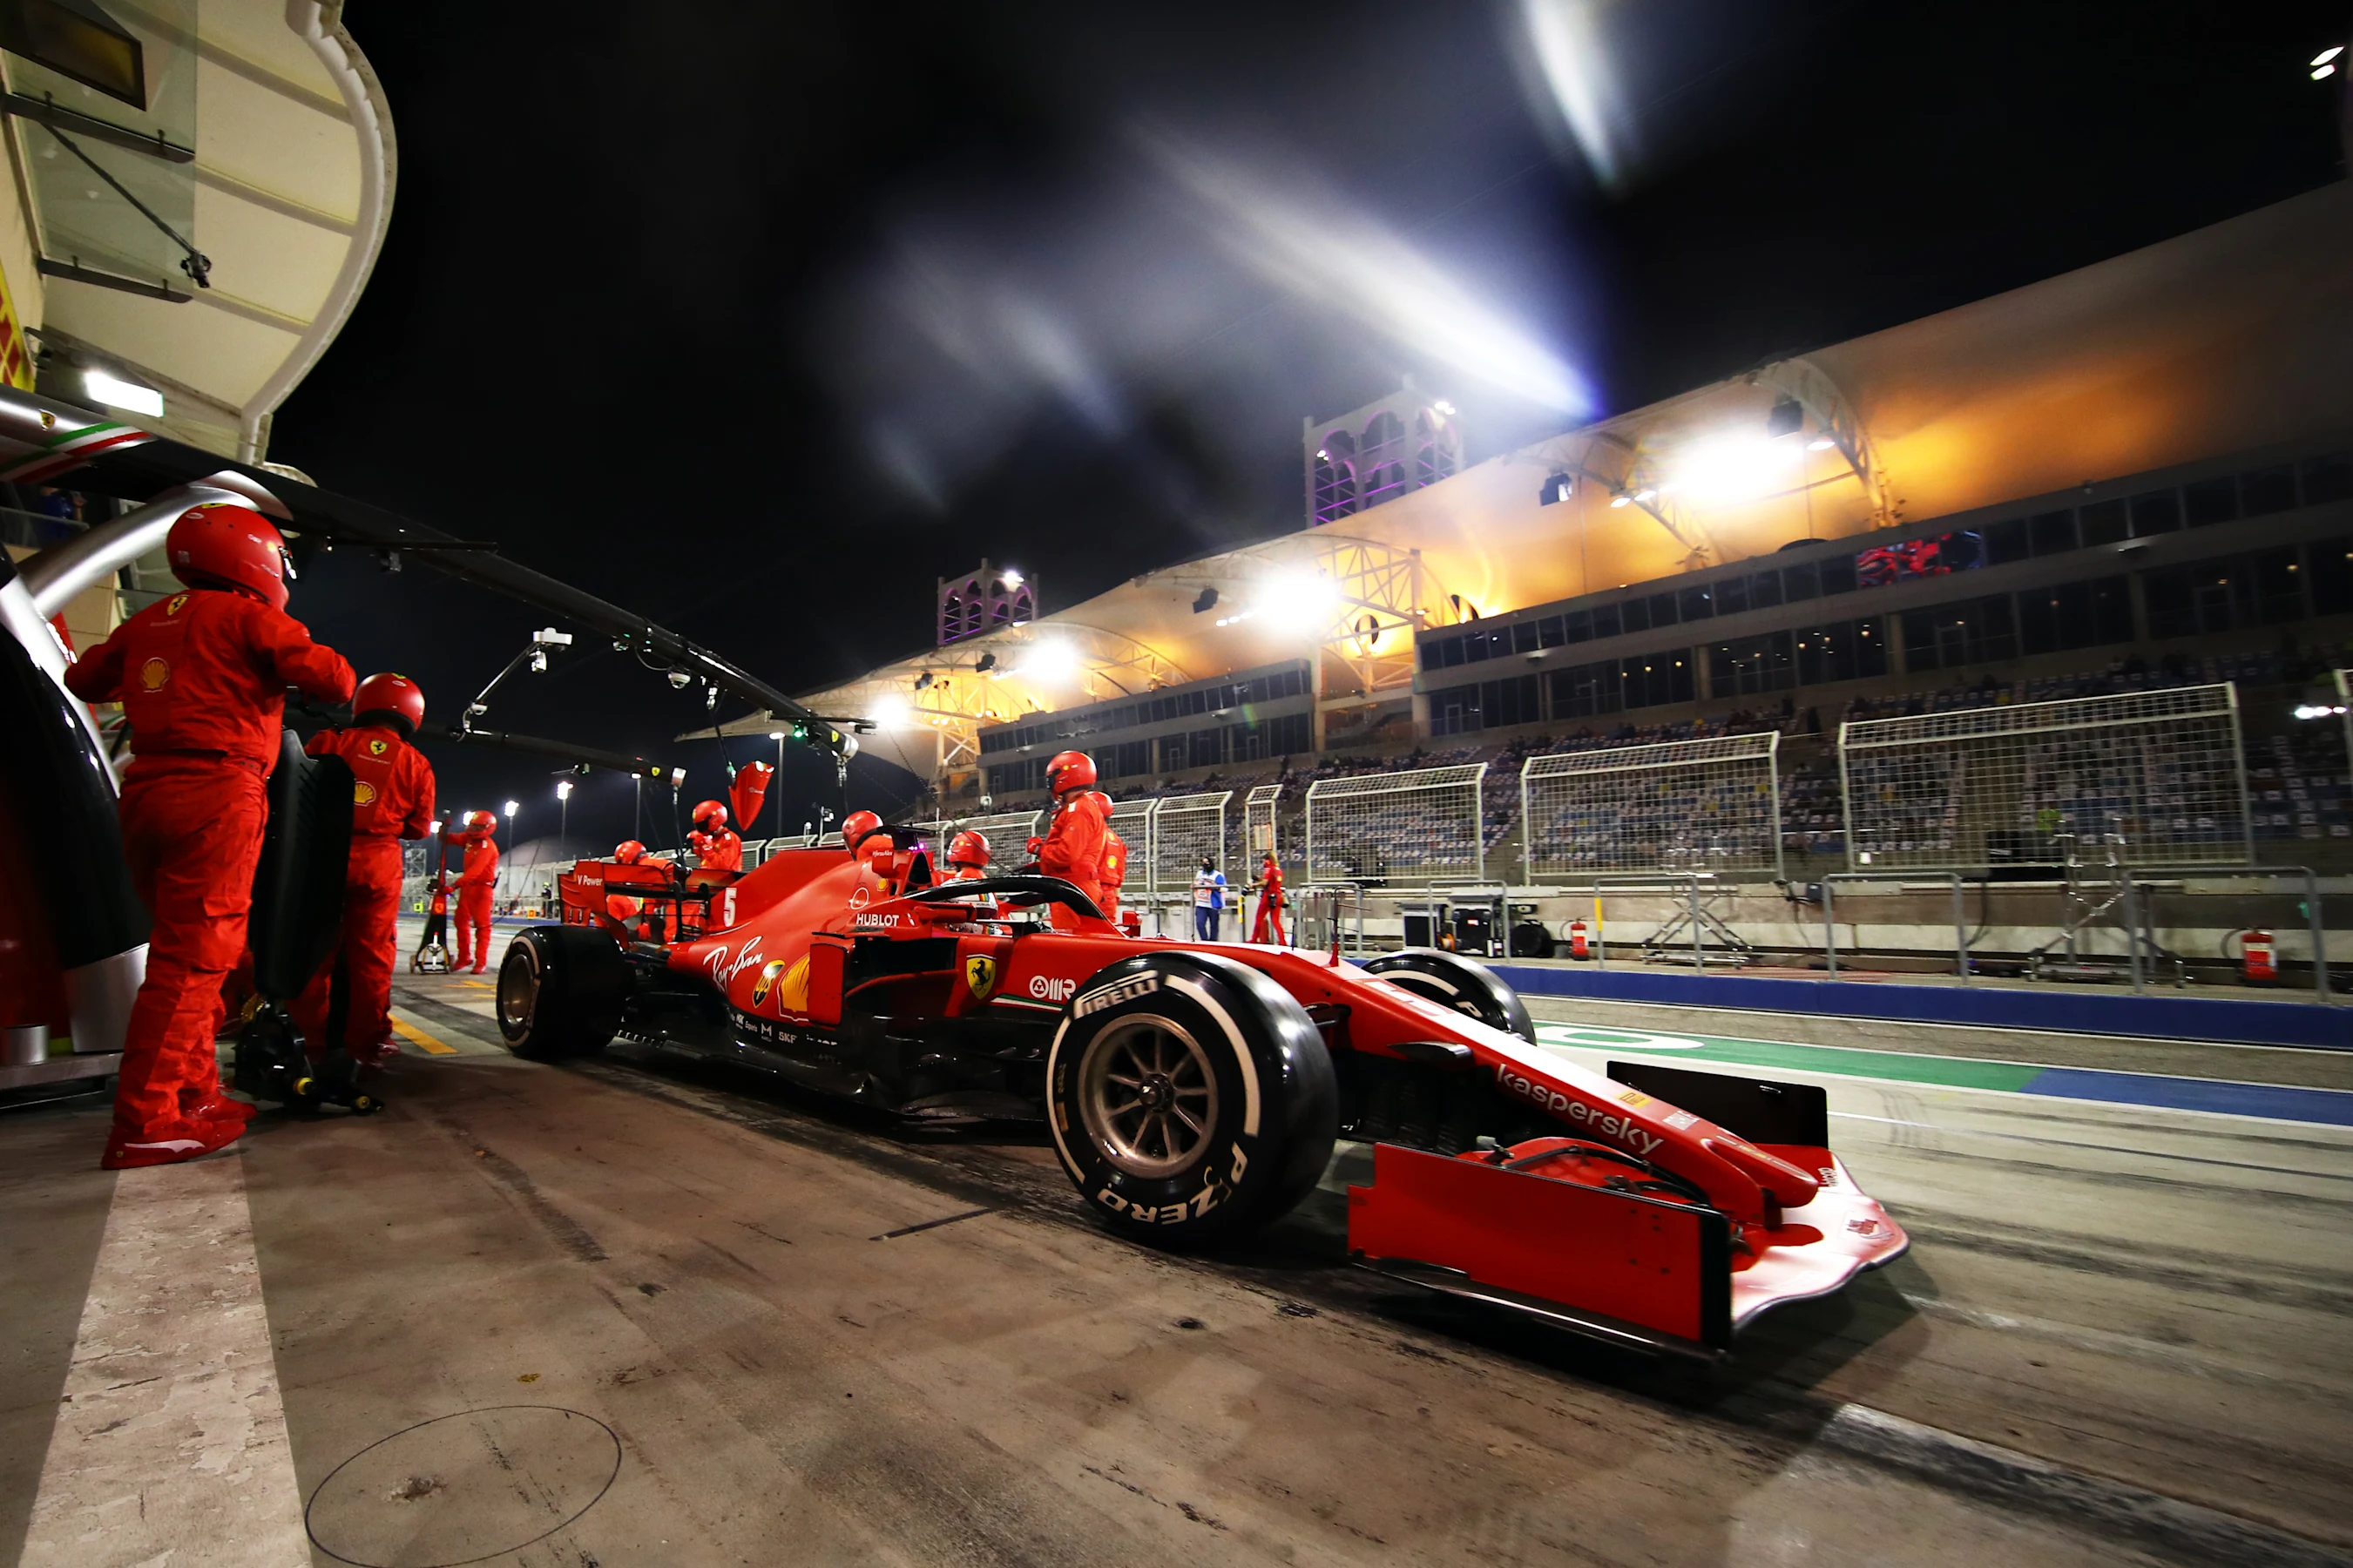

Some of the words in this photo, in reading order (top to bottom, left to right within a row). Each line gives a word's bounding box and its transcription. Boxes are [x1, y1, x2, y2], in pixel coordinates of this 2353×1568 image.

[578, 875, 583, 885] V
[583, 875, 603, 886] Power
[723, 887, 737, 927] 5
[855, 913, 899, 927] HUBLOT
[1073, 970, 1159, 1020] PIRELLI
[778, 1031, 797, 1044] SKF
[1497, 1062, 1665, 1155] kaspersky
[1231, 1141, 1248, 1186] P
[1096, 1186, 1219, 1226] ZERO
